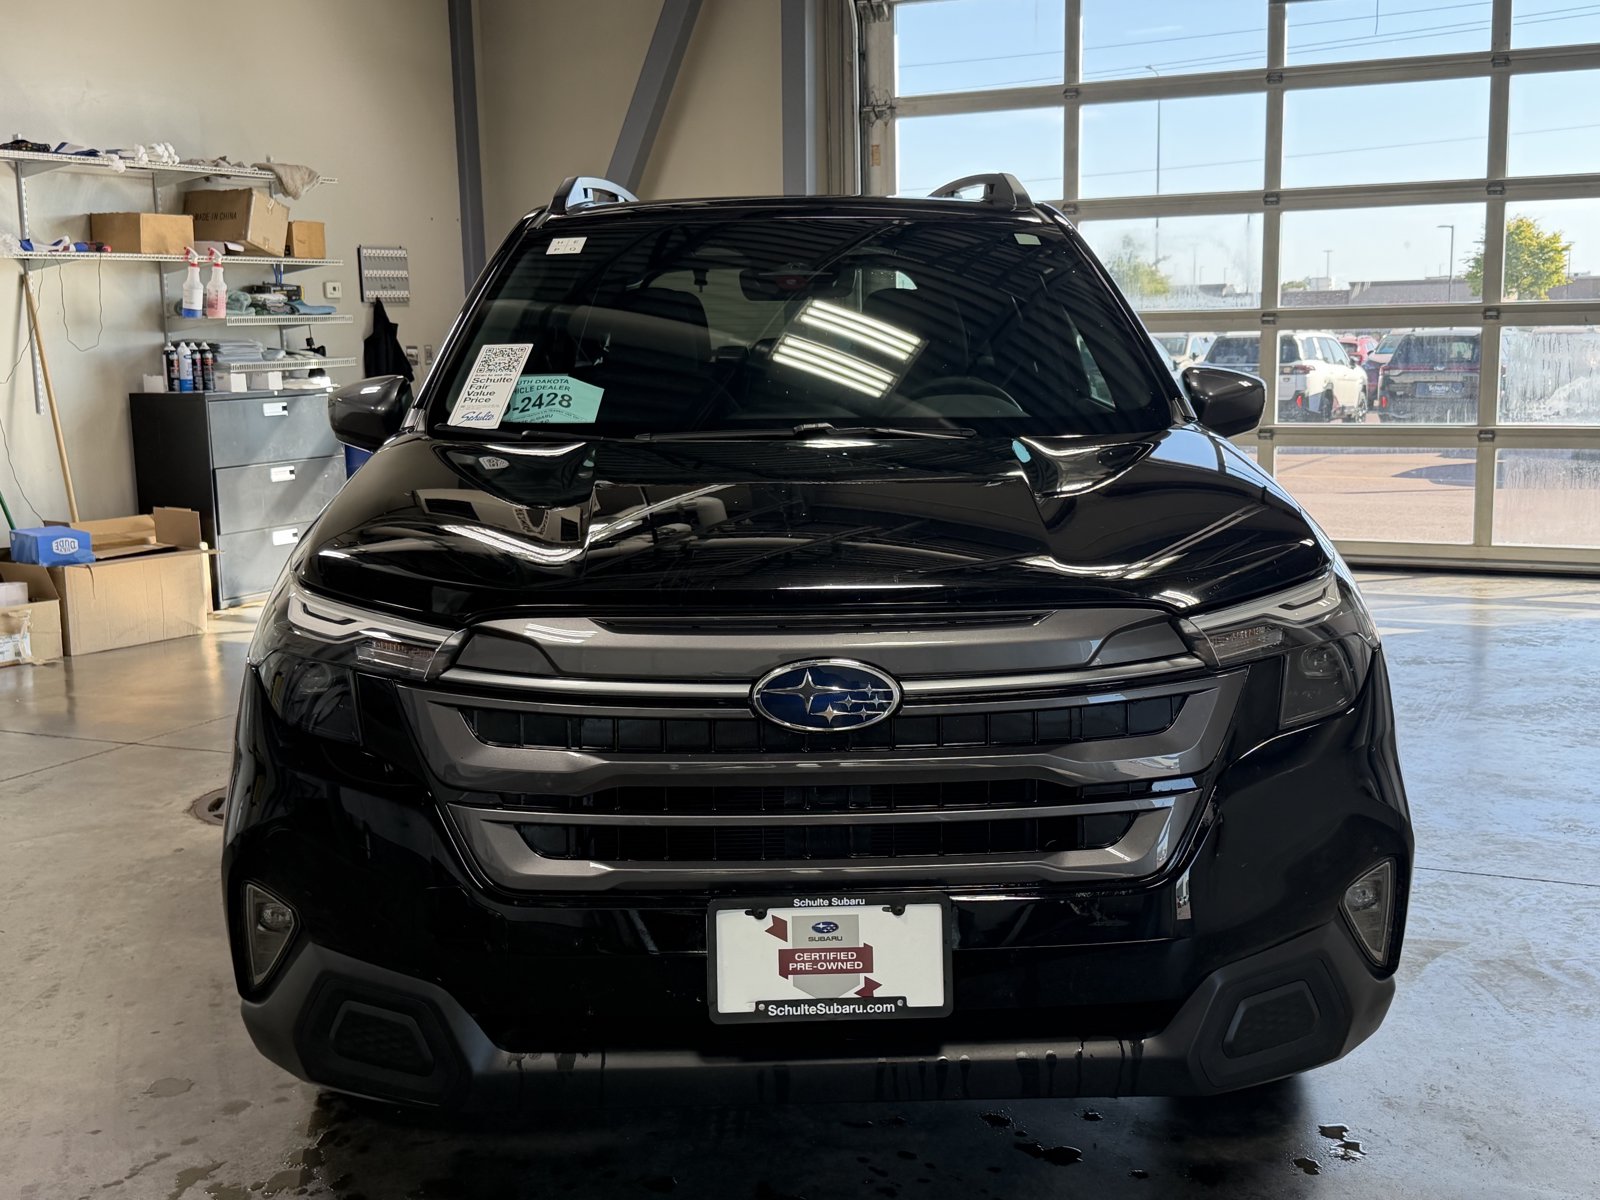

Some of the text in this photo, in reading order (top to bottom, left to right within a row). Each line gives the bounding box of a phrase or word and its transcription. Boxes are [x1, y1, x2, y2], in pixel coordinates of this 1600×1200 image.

[220, 211, 237, 220] CHINA
[513, 386, 535, 394] ICLE
[793, 897, 865, 907] Schulte Subaru
[795, 952, 857, 961] CERTIFIED
[789, 961, 863, 971] PRE-OWNED
[768, 1003, 895, 1016] SchulteSubaru.com
